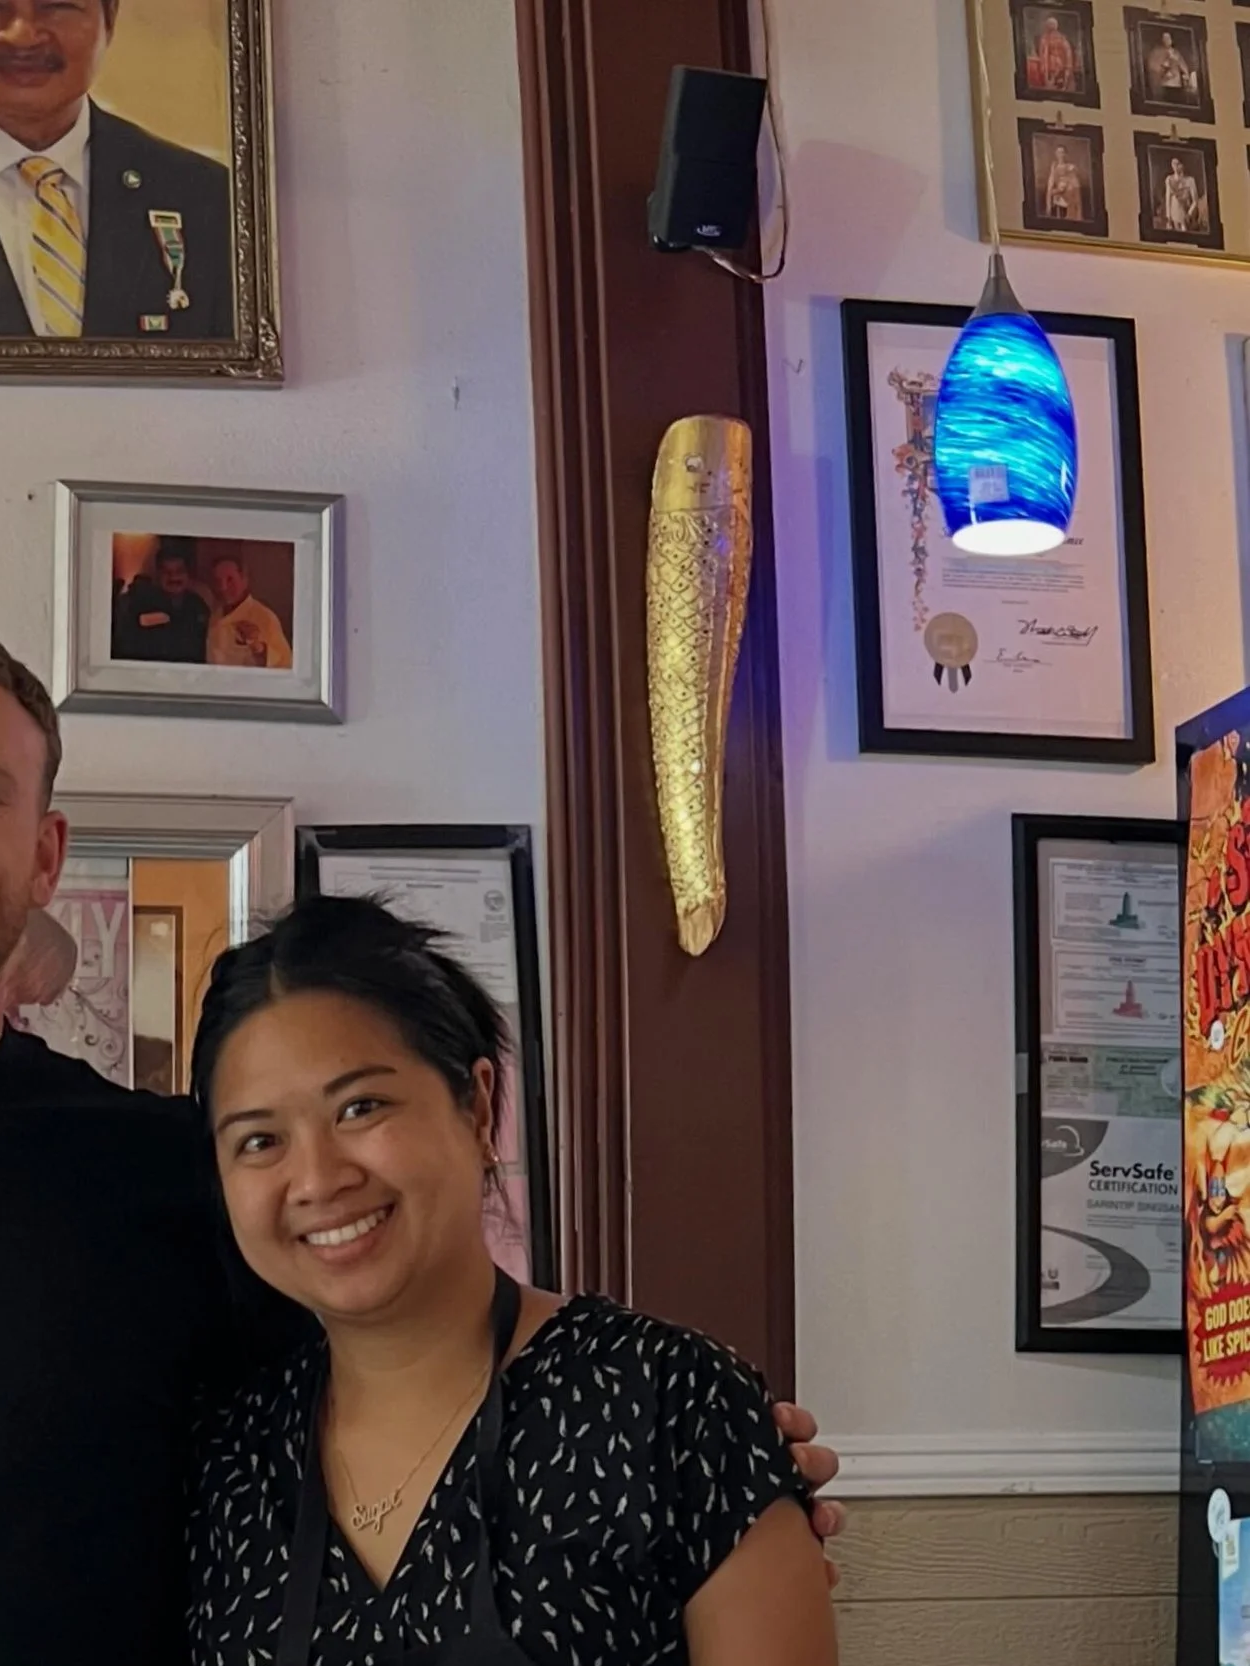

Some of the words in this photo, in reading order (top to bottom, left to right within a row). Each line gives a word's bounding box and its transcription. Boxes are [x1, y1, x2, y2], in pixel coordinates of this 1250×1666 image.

[1089, 1160, 1175, 1180] ServSafe
[1088, 1180, 1178, 1195] CERTIFICATION
[1205, 1303, 1227, 1331] GOD
[1203, 1334, 1225, 1362] LIKE
